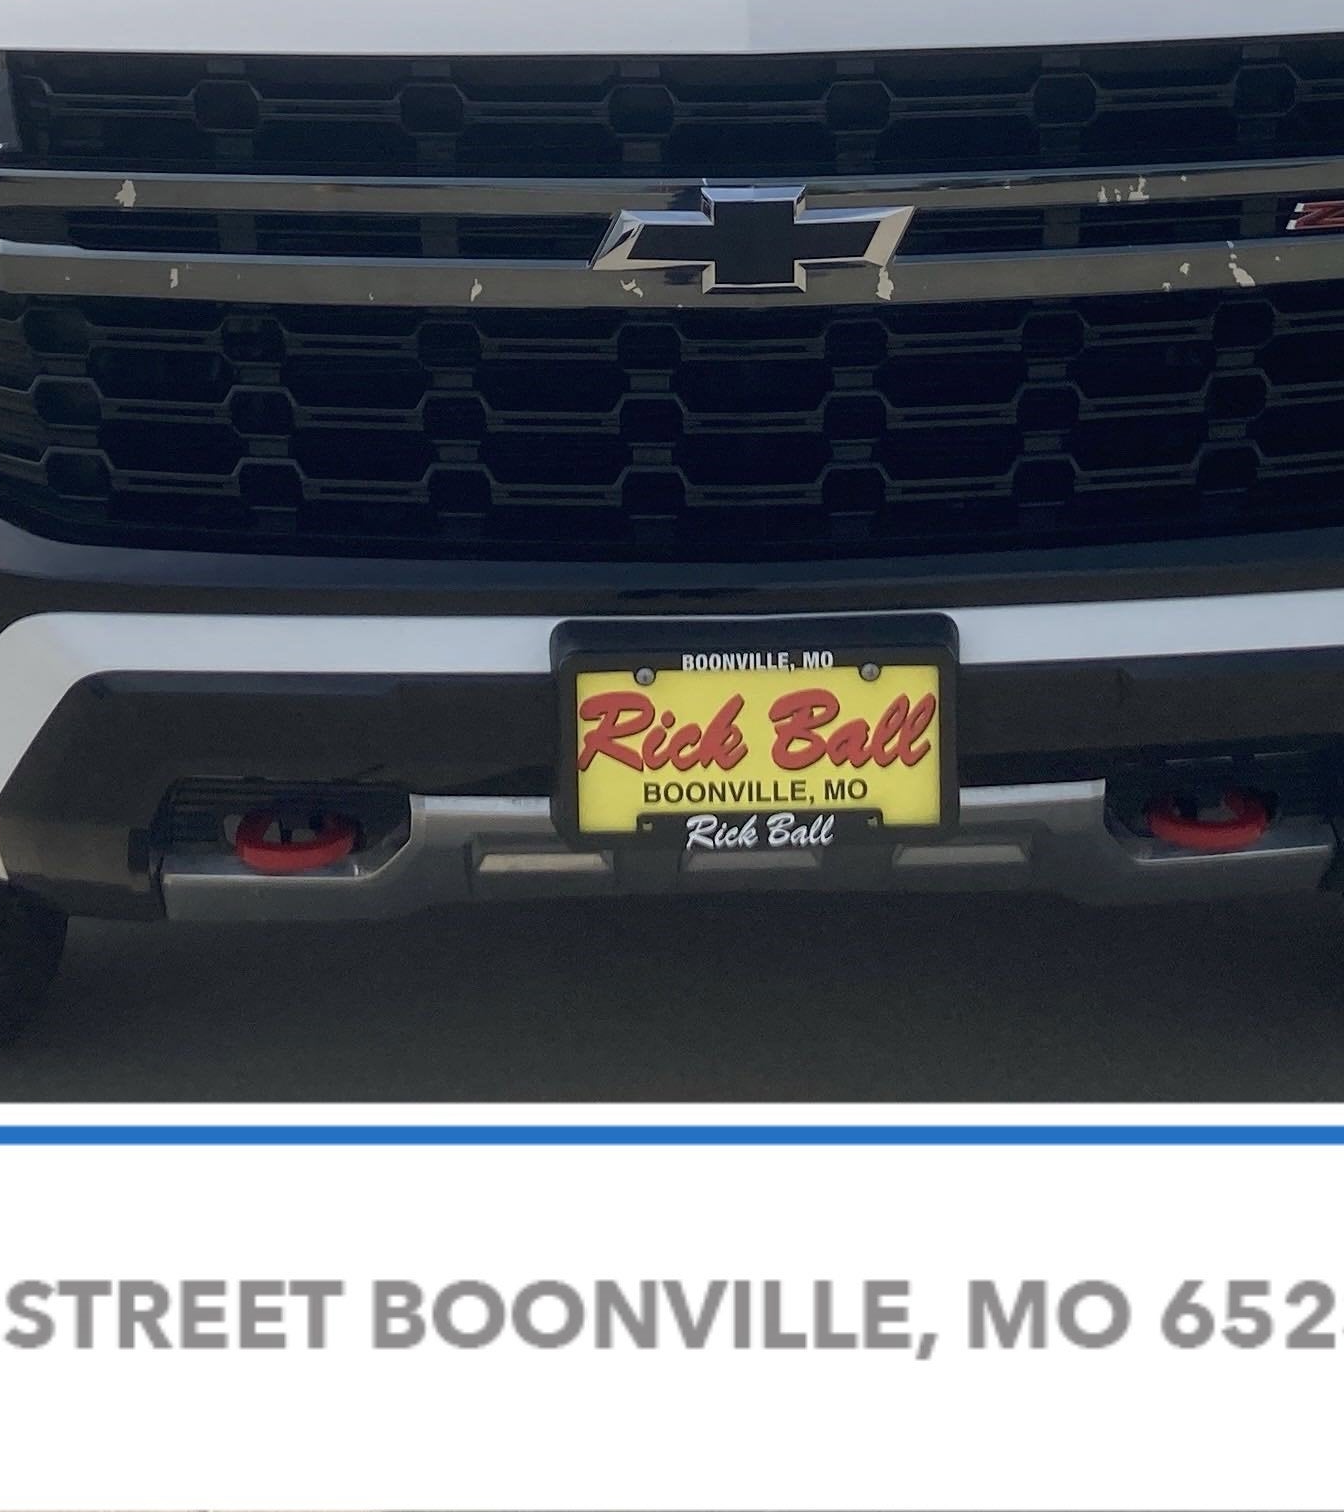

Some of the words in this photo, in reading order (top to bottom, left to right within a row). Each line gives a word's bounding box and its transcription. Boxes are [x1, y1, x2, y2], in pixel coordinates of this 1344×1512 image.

[682, 651, 795, 672] BOONVILLE,
[803, 650, 834, 671] MO
[577, 690, 748, 772] Rick
[768, 688, 936, 771] Ball
[643, 779, 815, 805] BOONVILLE,
[824, 778, 868, 800] MO
[686, 814, 758, 851] Rick
[766, 812, 835, 847] Ball
